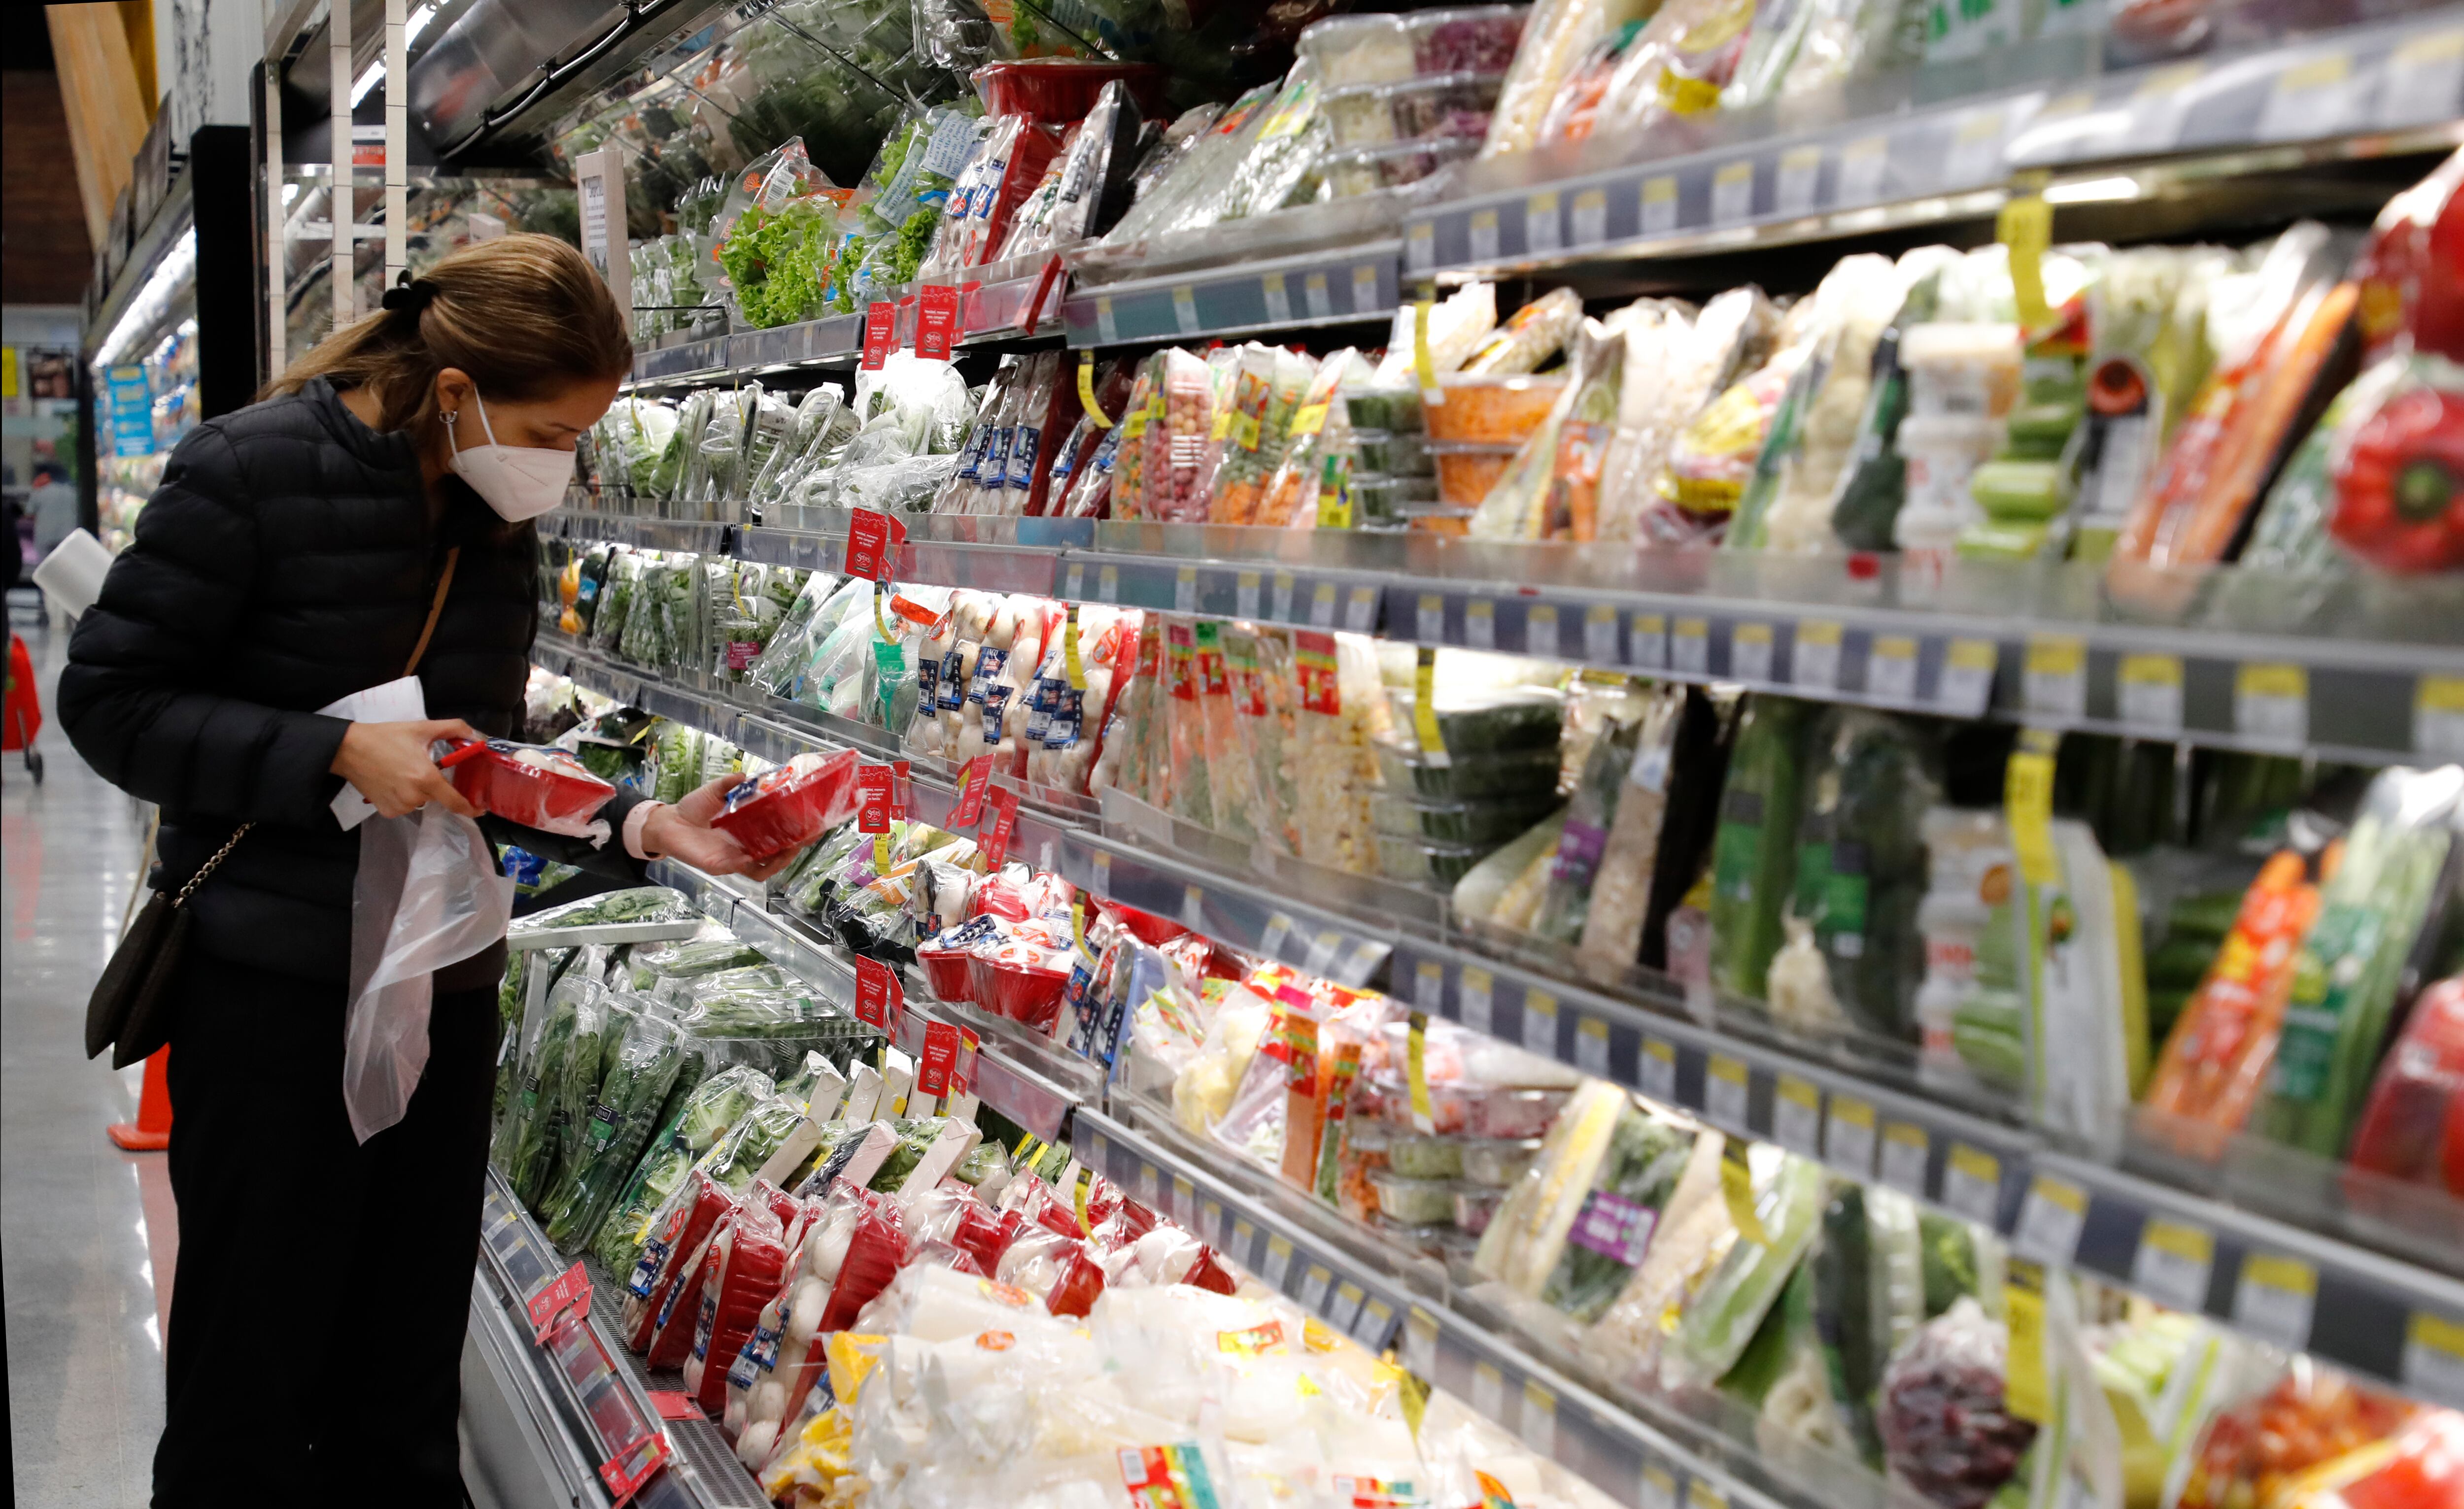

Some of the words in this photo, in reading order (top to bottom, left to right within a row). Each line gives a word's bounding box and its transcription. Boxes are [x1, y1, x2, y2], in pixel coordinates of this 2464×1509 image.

[926, 334, 940, 342] Setas
[857, 554, 870, 563] Setas
[929, 1070, 941, 1078] Setas
